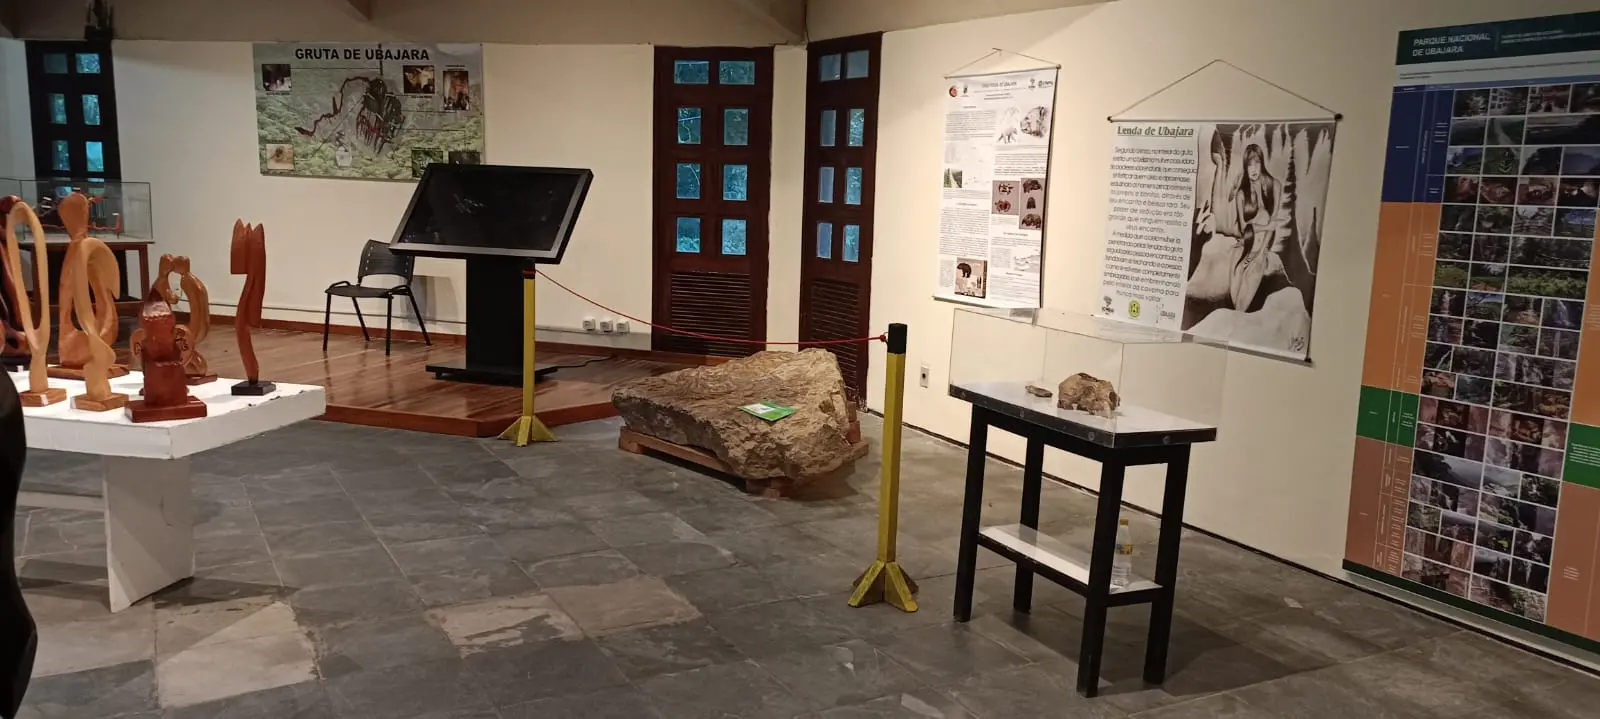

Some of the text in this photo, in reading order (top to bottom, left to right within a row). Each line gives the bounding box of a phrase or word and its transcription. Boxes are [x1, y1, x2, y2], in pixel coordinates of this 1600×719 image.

[1413, 37, 1447, 46] PARQUE
[1447, 33, 1491, 43] NACIONAL
[295, 48, 430, 60] GRUTA DE UBAJARA
[1412, 46, 1464, 57] DE UBAJARA
[1117, 126, 1194, 138] Lenda de Ubajara
